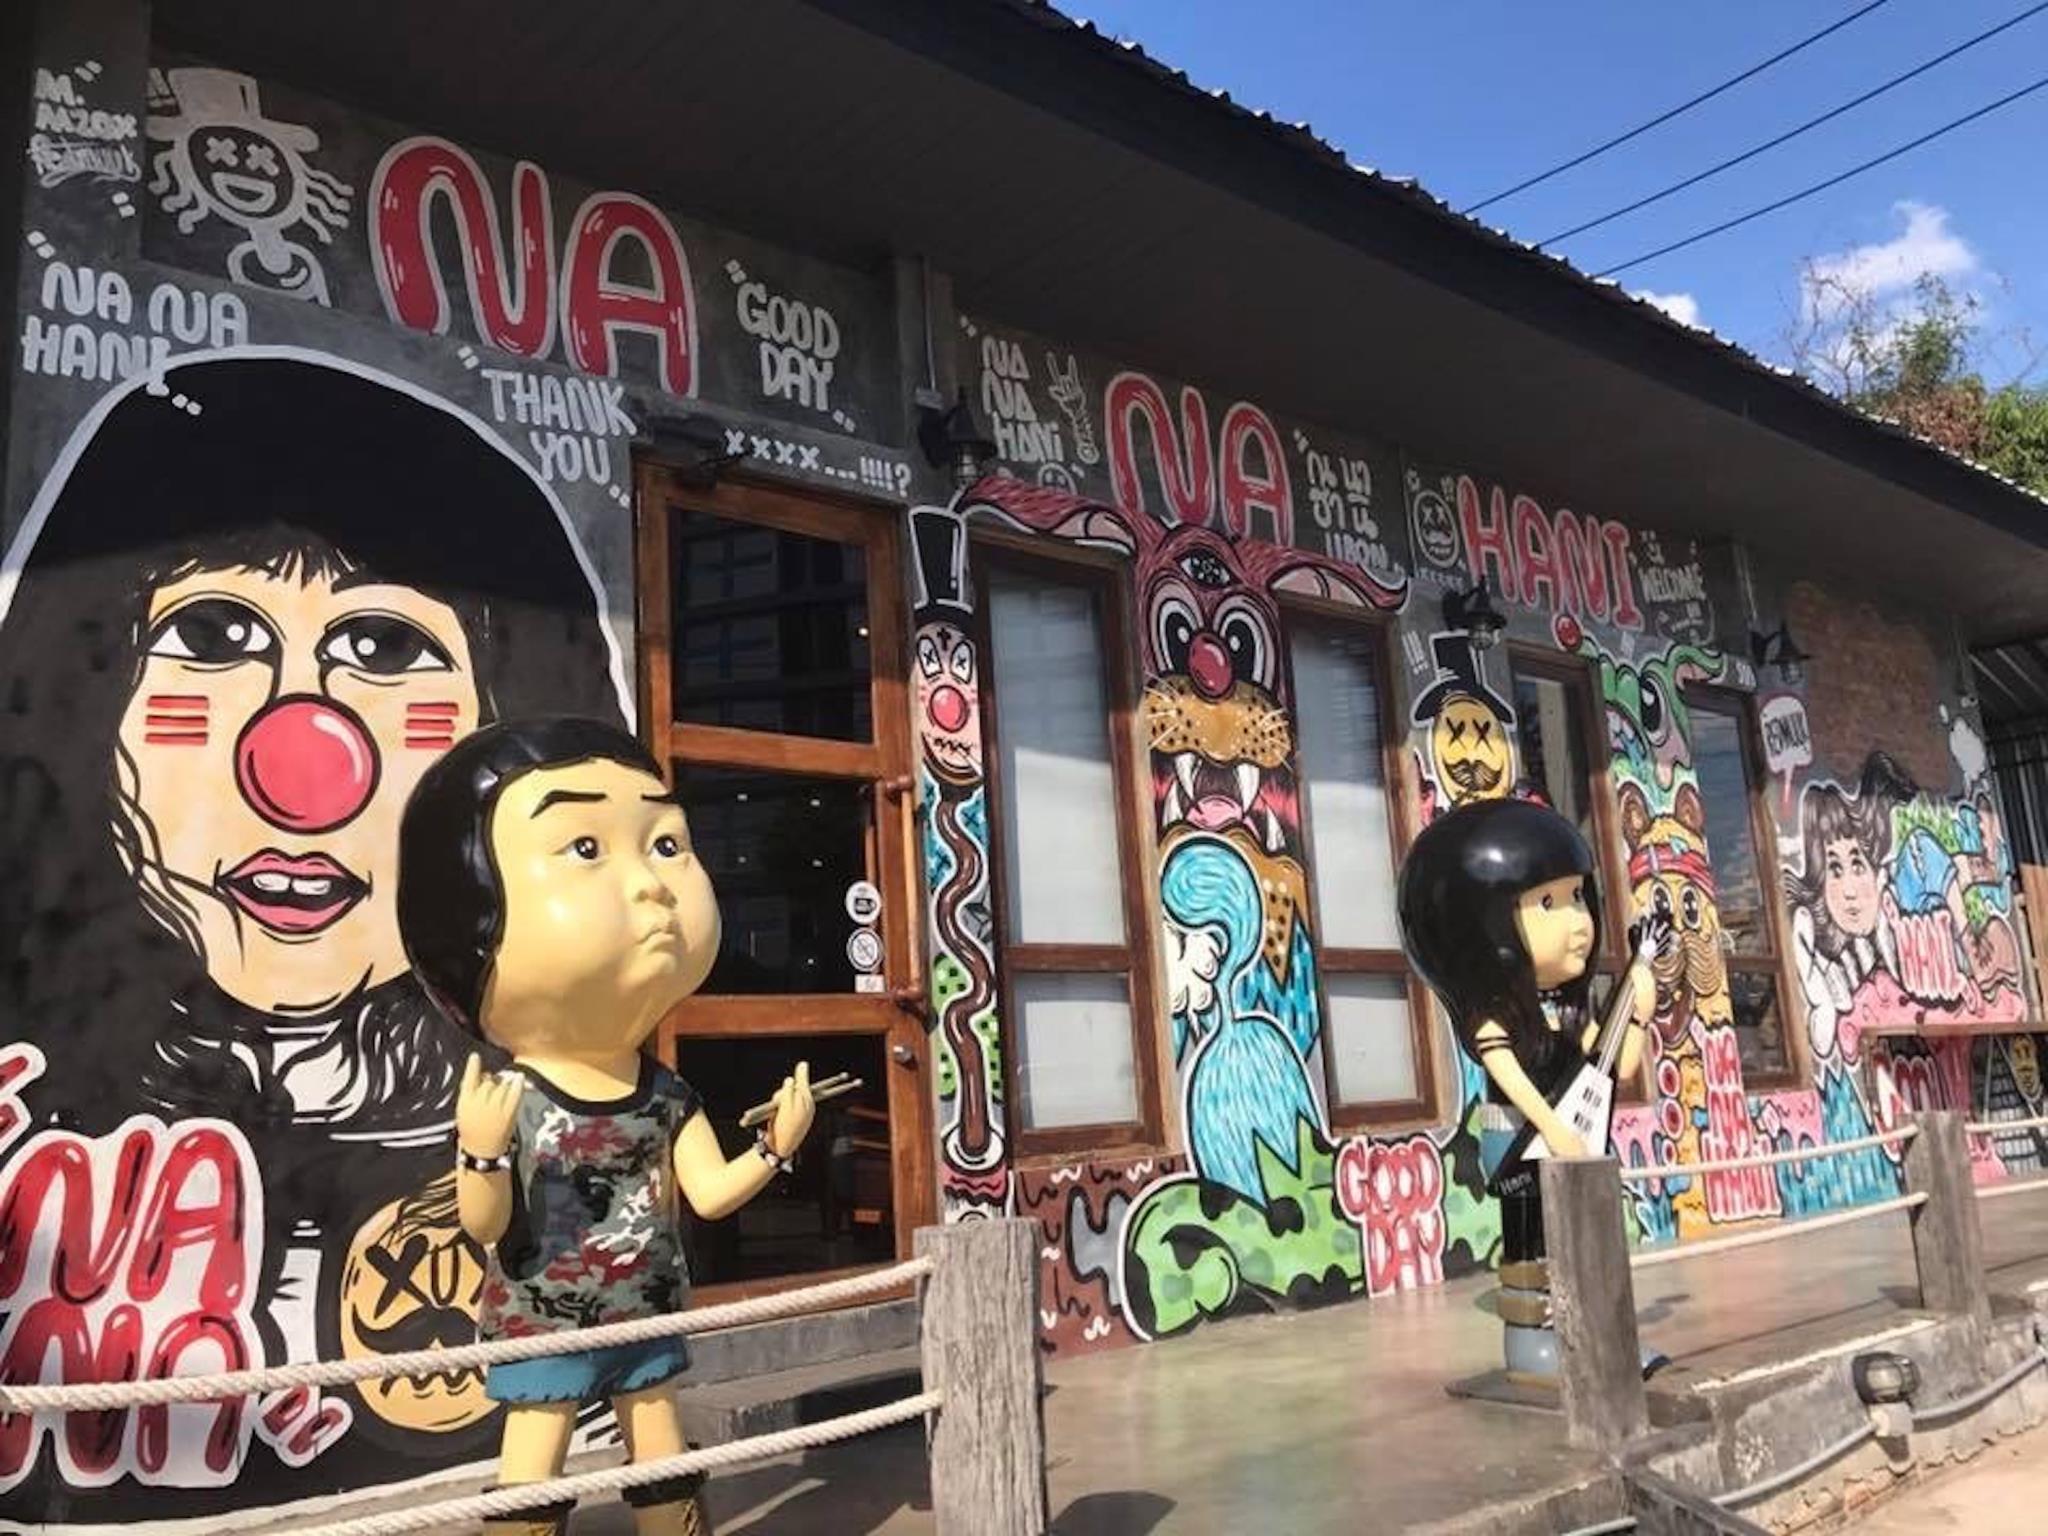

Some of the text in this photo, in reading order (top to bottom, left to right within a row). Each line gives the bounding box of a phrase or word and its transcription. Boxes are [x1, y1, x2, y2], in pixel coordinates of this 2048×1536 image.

[42, 262, 248, 347] NA NA
[369, 136, 698, 399] NA
[737, 282, 840, 358] GOOD
[481, 367, 638, 436] THANK
[760, 343, 835, 412] DAY
[530, 431, 612, 485] YOU
[1104, 371, 1295, 547] NA
[1457, 475, 1644, 632] HANI
[0, 1132, 252, 1303] NA
[1338, 1138, 1442, 1216] GOOD
